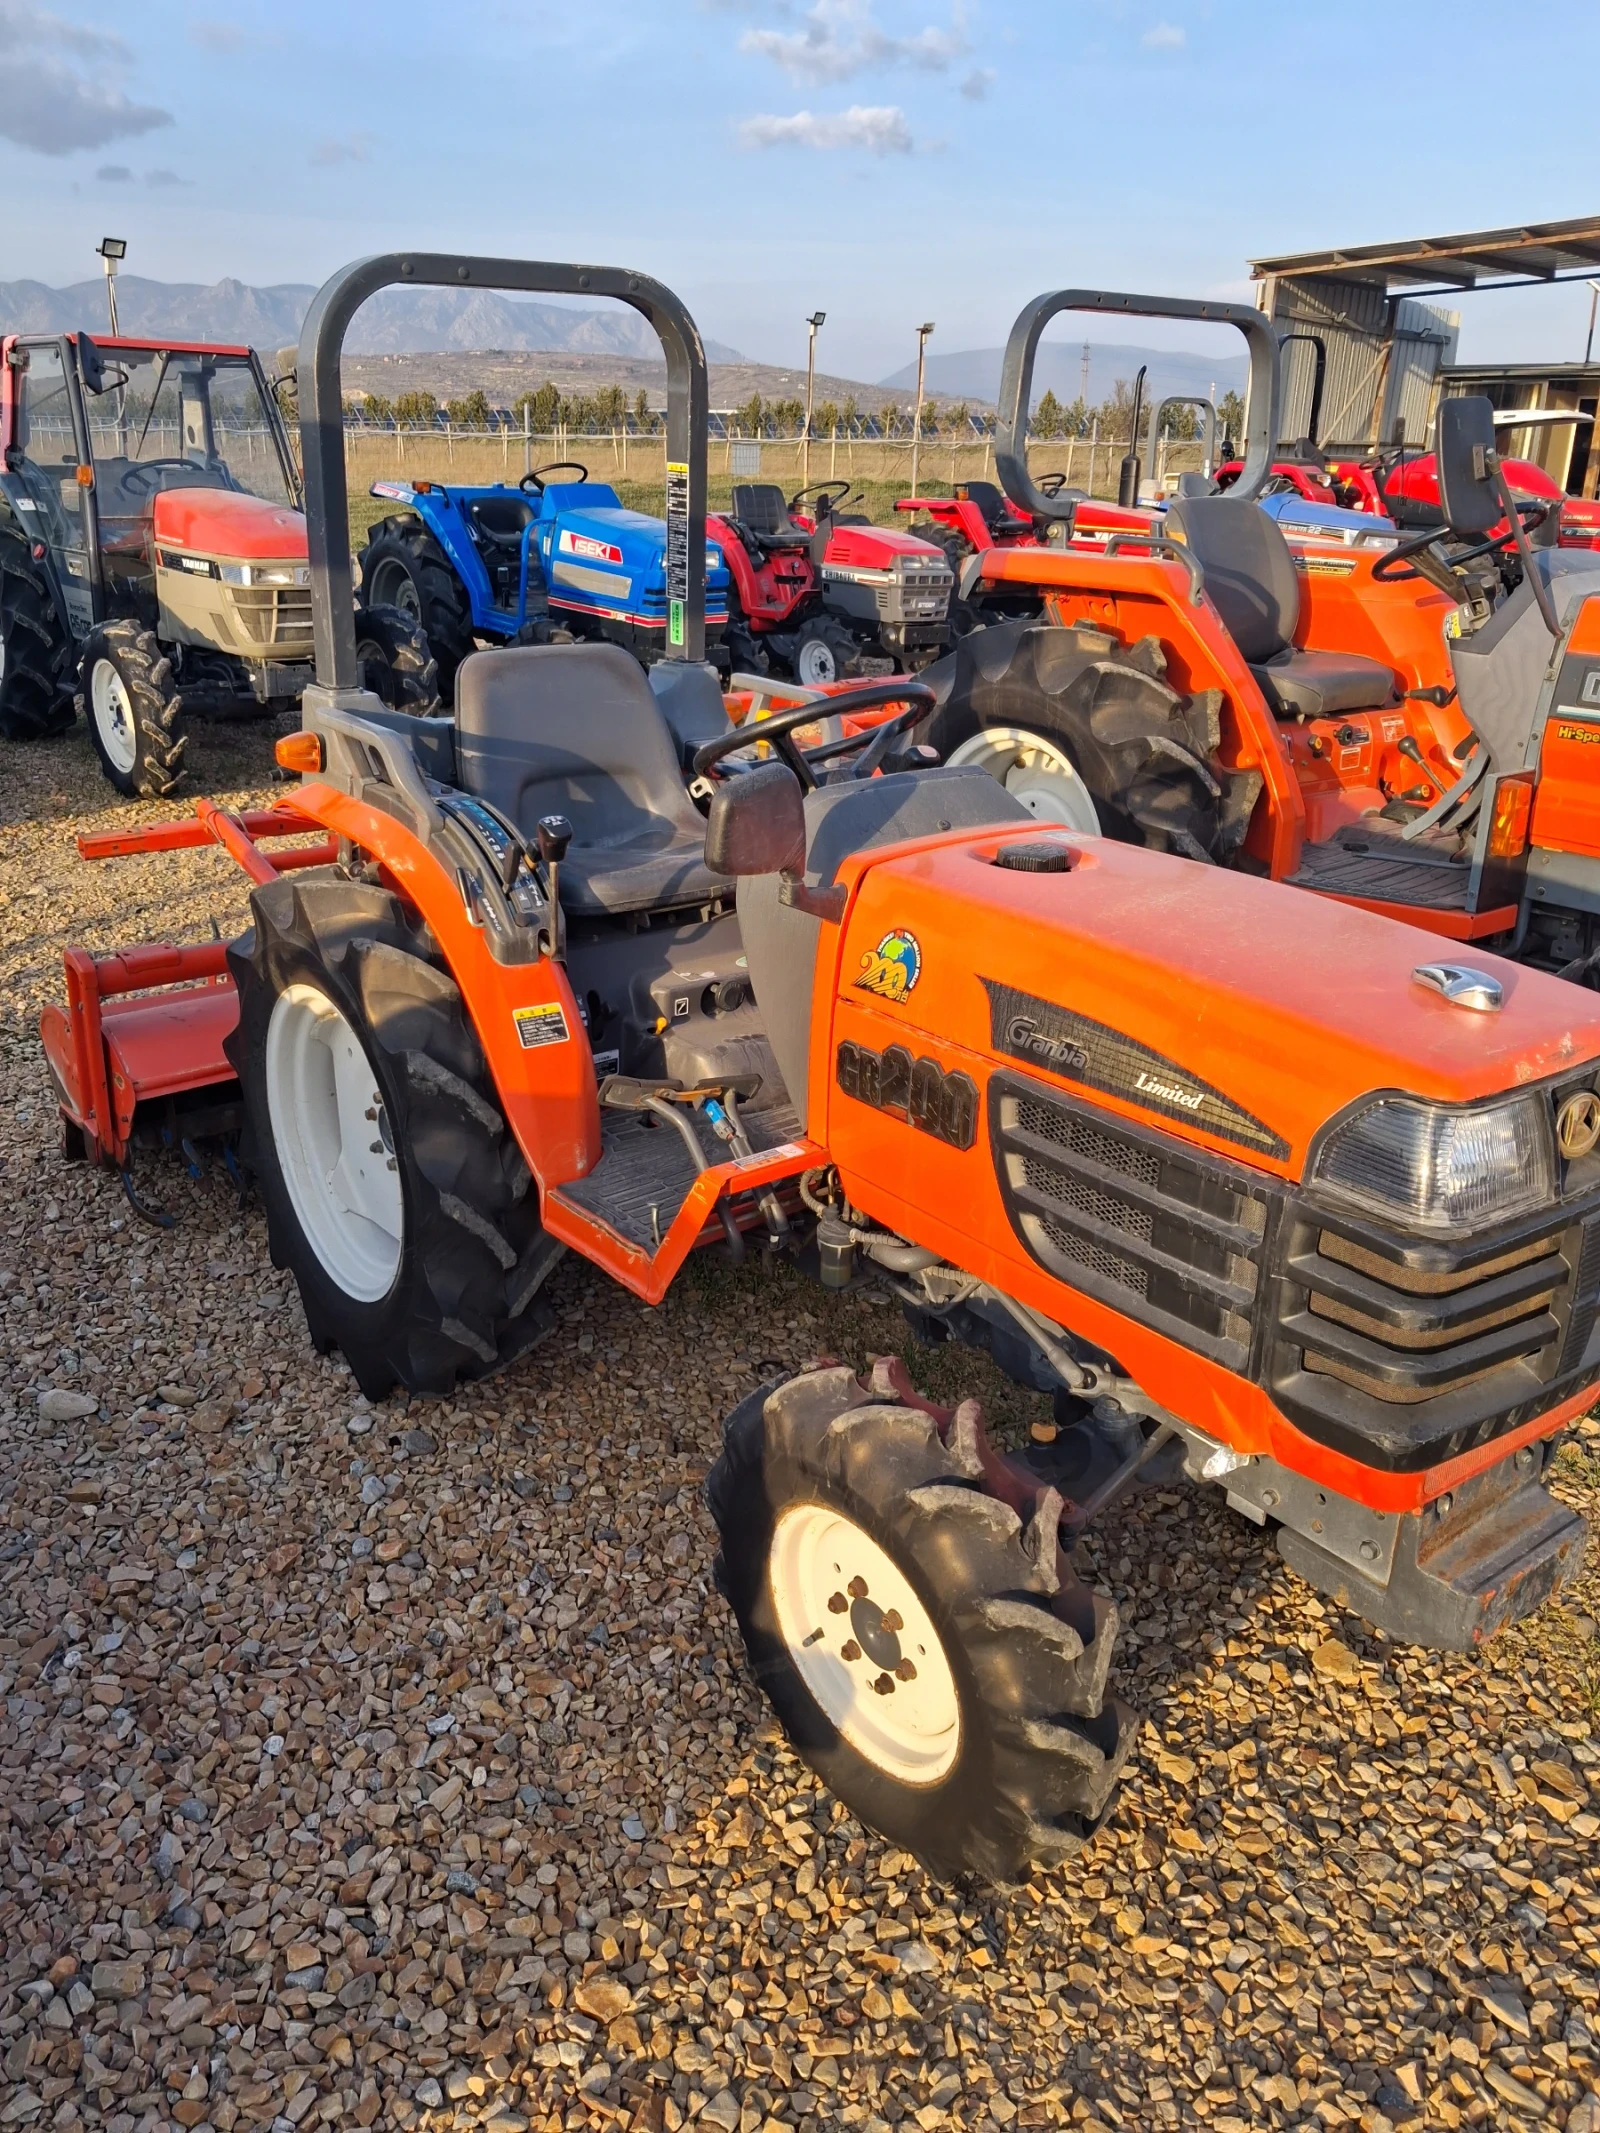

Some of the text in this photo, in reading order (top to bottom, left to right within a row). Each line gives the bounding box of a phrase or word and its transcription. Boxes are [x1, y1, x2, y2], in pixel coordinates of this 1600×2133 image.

[1309, 526, 1321, 534] 22
[574, 539, 610, 559] ISEKI
[182, 558, 210, 572] YANMAR
[825, 570, 855, 580] SHIBAURA
[1008, 1018, 1087, 1070] Granbia
[1134, 1072, 1205, 1110] Limited
